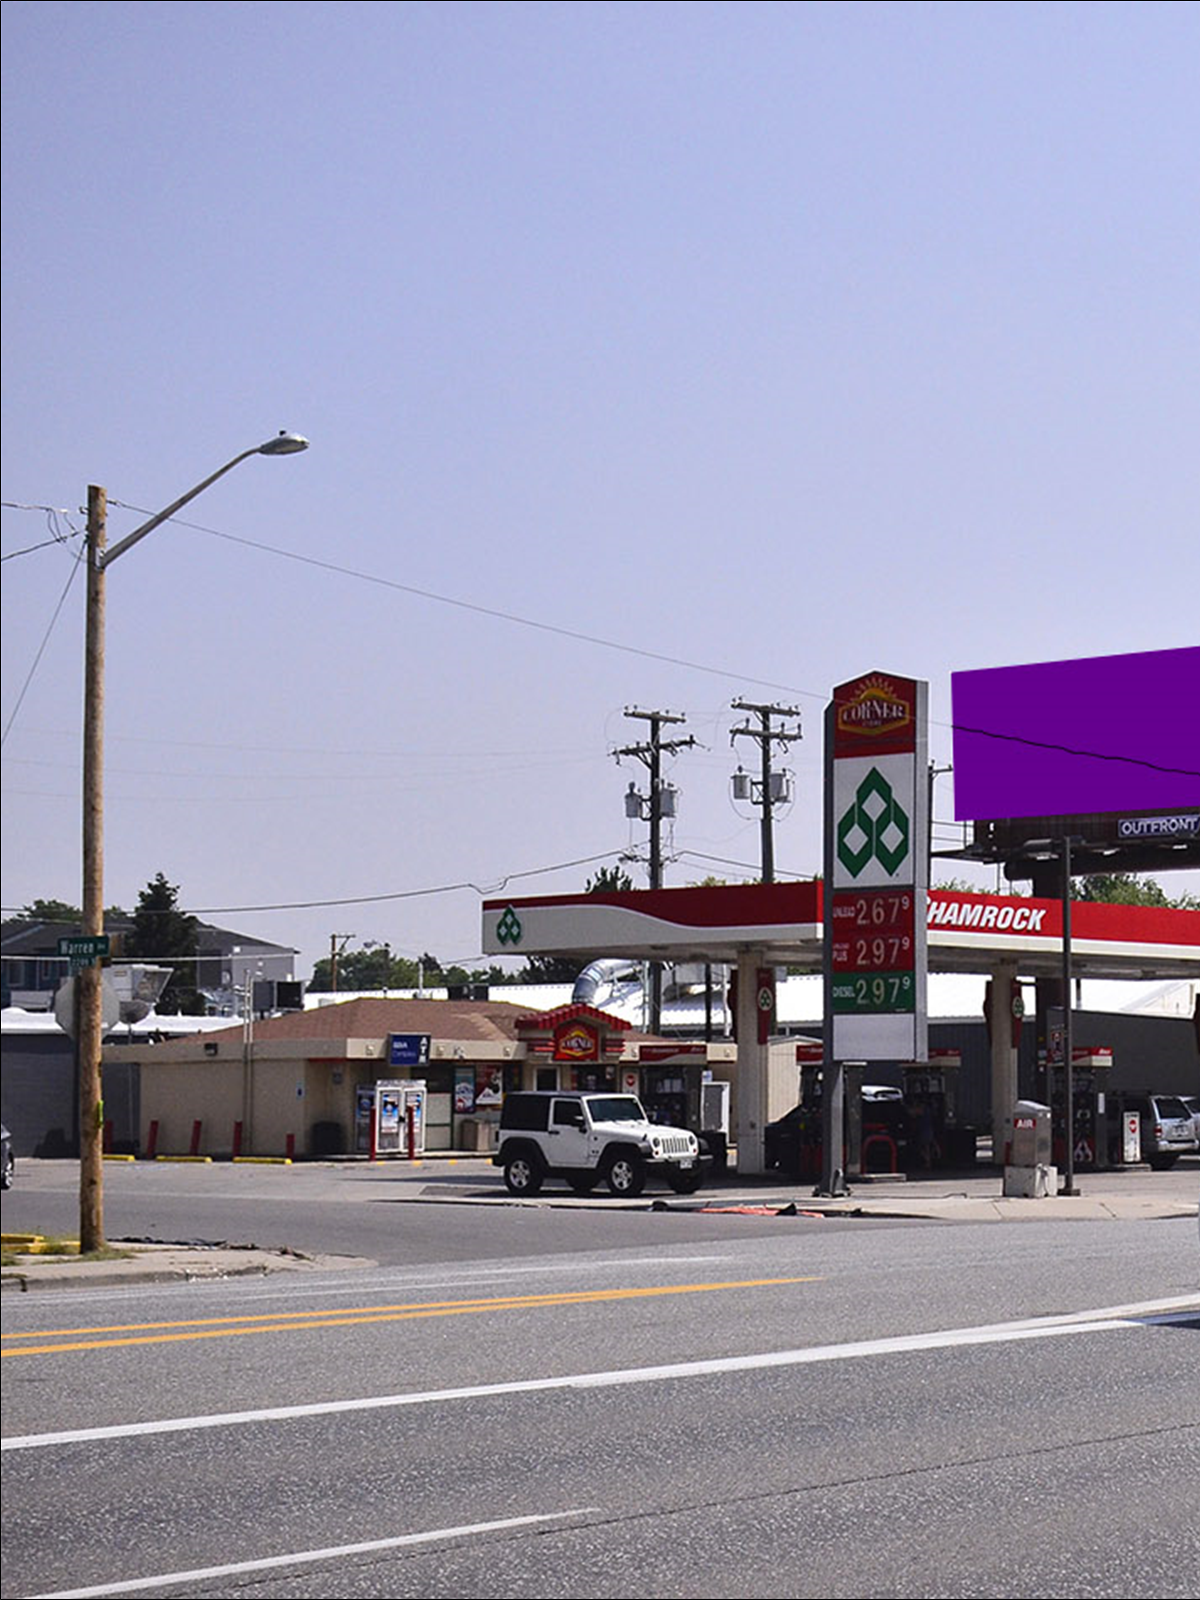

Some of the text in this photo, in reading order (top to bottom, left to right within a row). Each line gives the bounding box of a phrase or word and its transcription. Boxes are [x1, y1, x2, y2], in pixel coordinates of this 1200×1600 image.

[842, 700, 904, 721] CORNER
[1121, 817, 1199, 835] OUTFRONT
[832, 906, 855, 918] UNLEAD
[926, 896, 1047, 932] HAMROCK
[60, 940, 94, 955] Warren
[832, 950, 848, 962] PLUS
[832, 985, 855, 998] DIESEL
[1016, 1119, 1034, 1129] AIR
